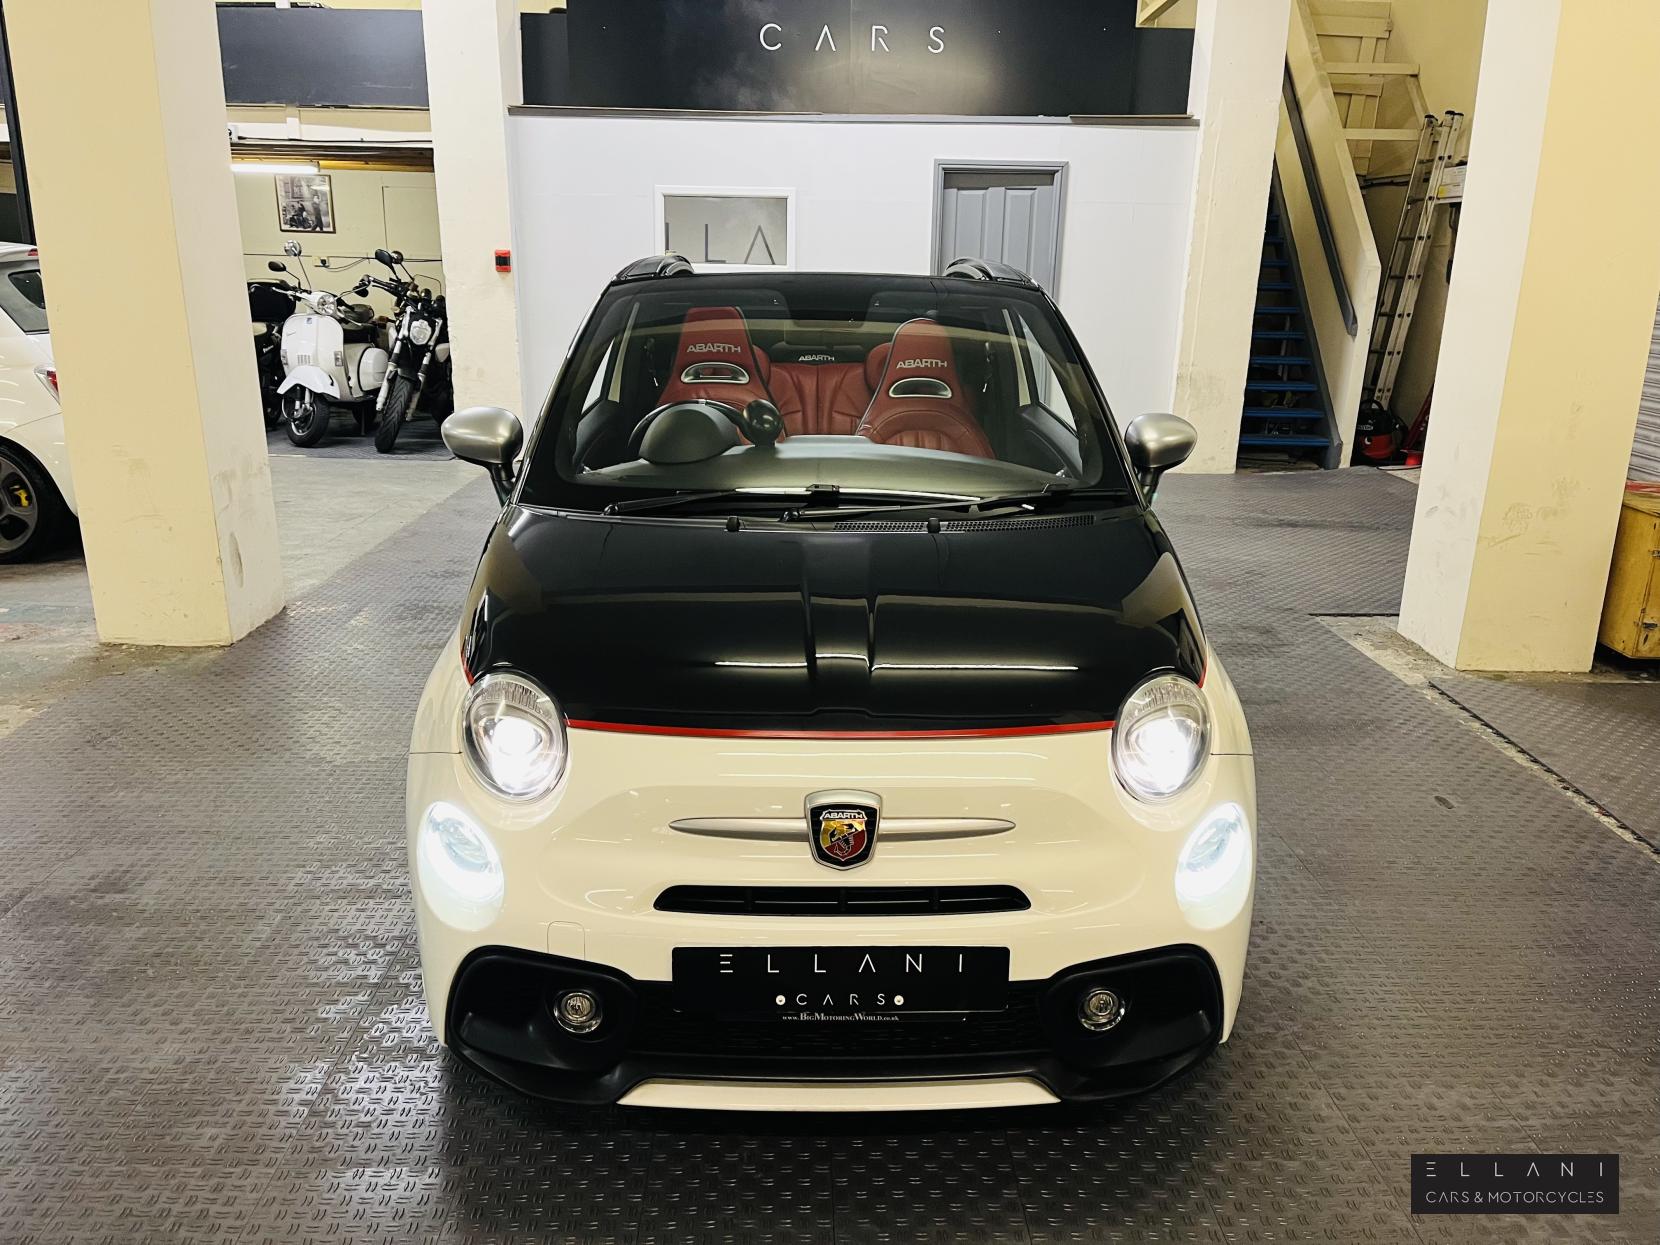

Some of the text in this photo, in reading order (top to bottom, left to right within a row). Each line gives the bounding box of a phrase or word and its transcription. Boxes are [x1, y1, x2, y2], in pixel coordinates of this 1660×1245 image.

[759, 23, 945, 53] CARS
[686, 343, 741, 353] ABARTH
[896, 358, 947, 369] ABARTH
[719, 953, 963, 973] ELLANI
[796, 993, 886, 1006] CARS
